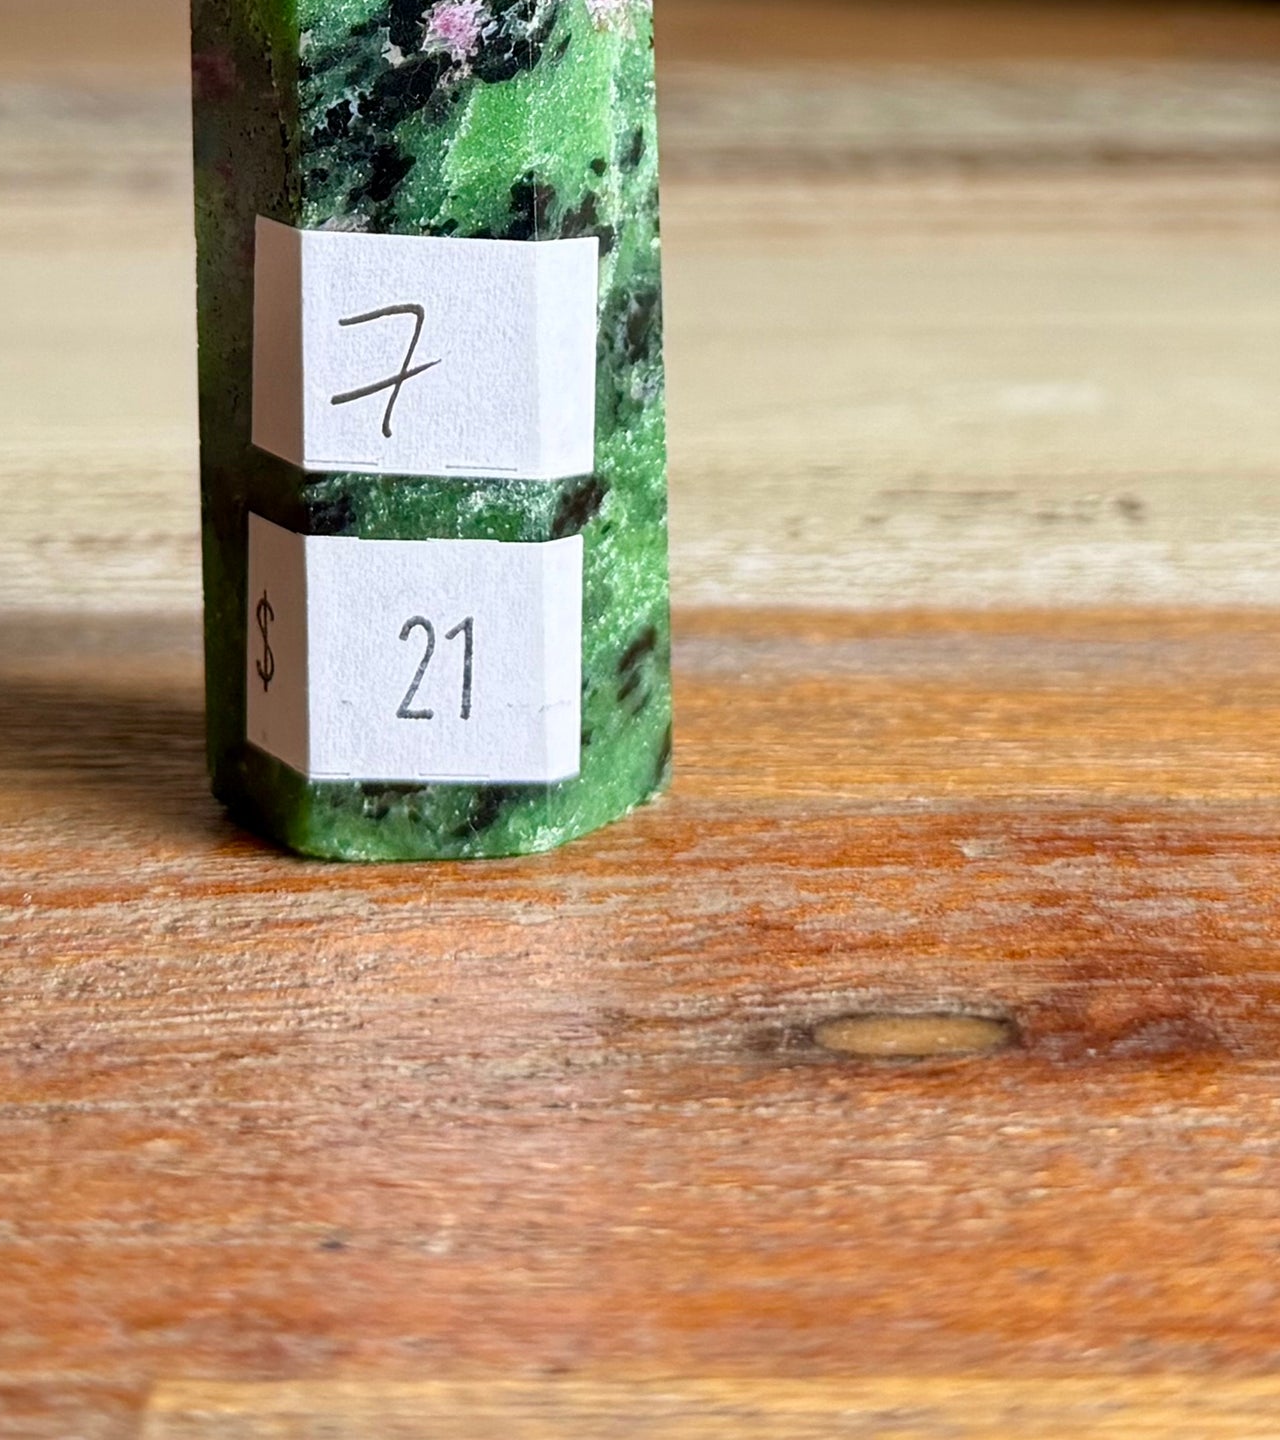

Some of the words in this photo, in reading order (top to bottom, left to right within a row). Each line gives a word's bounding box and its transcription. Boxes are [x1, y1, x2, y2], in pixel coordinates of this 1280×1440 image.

[330, 303, 442, 439] 7
[255, 589, 276, 692] $
[395, 614, 475, 721] 21
